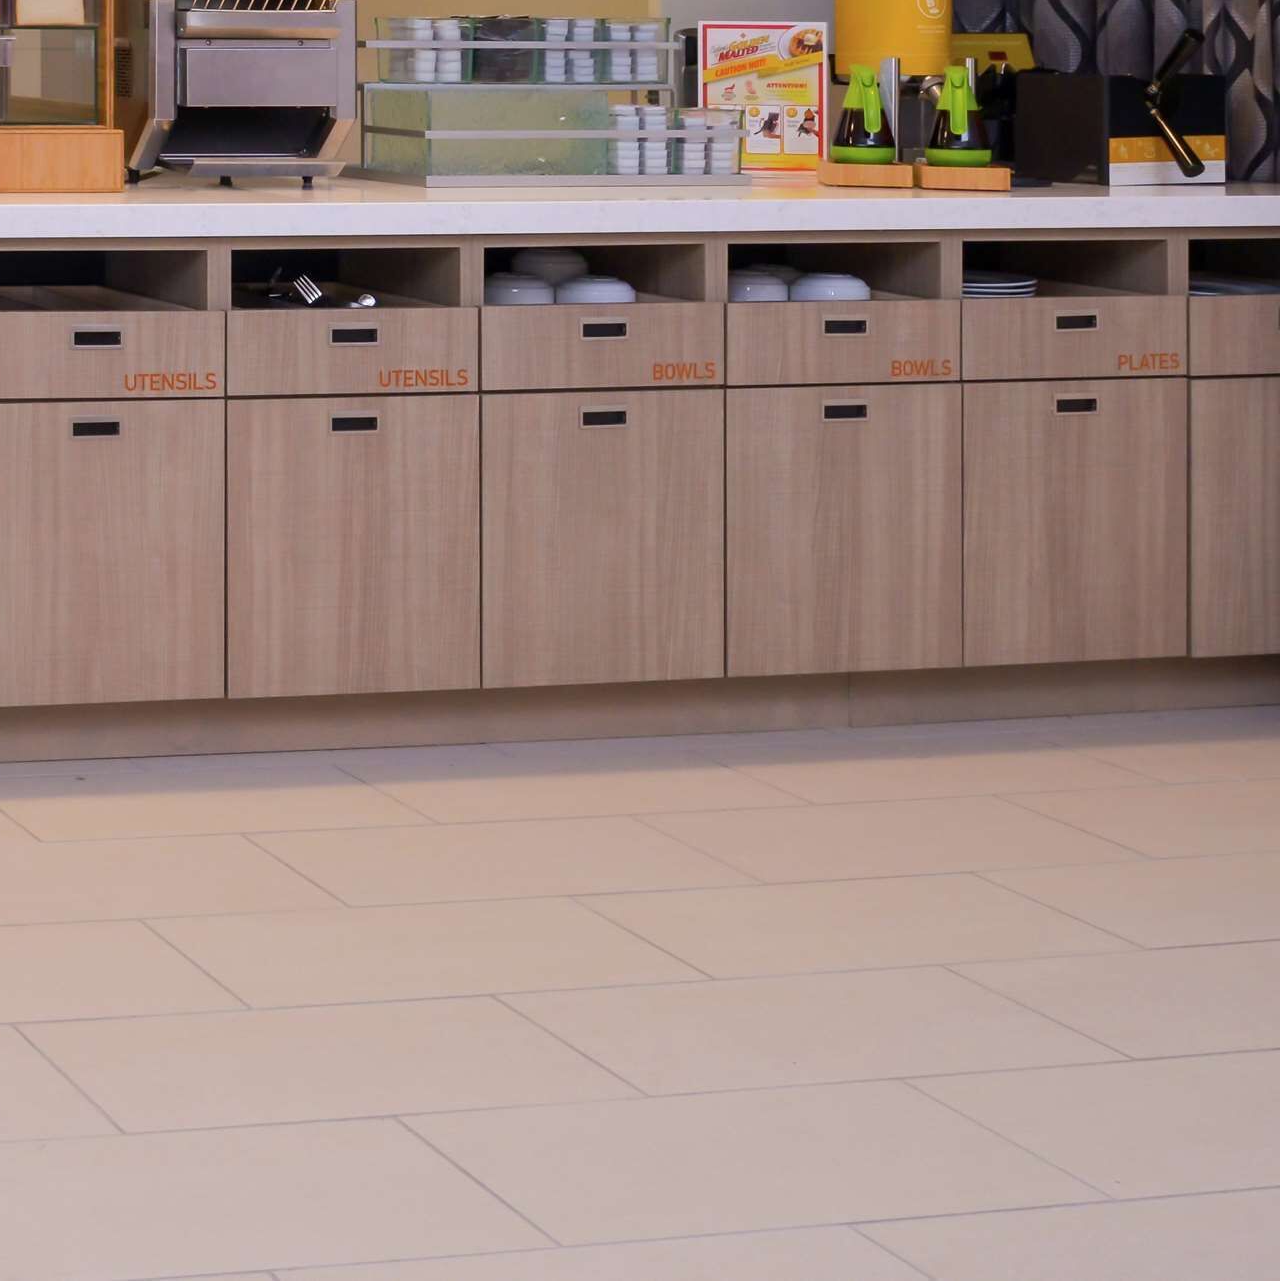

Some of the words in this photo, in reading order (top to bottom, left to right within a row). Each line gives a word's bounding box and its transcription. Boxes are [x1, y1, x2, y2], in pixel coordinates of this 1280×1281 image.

[651, 361, 716, 381] BOWLS
[890, 358, 952, 377] BOWLS
[1117, 352, 1181, 371] PLATES
[124, 372, 217, 392] UTENSILS
[378, 368, 469, 389] UTENSILS
